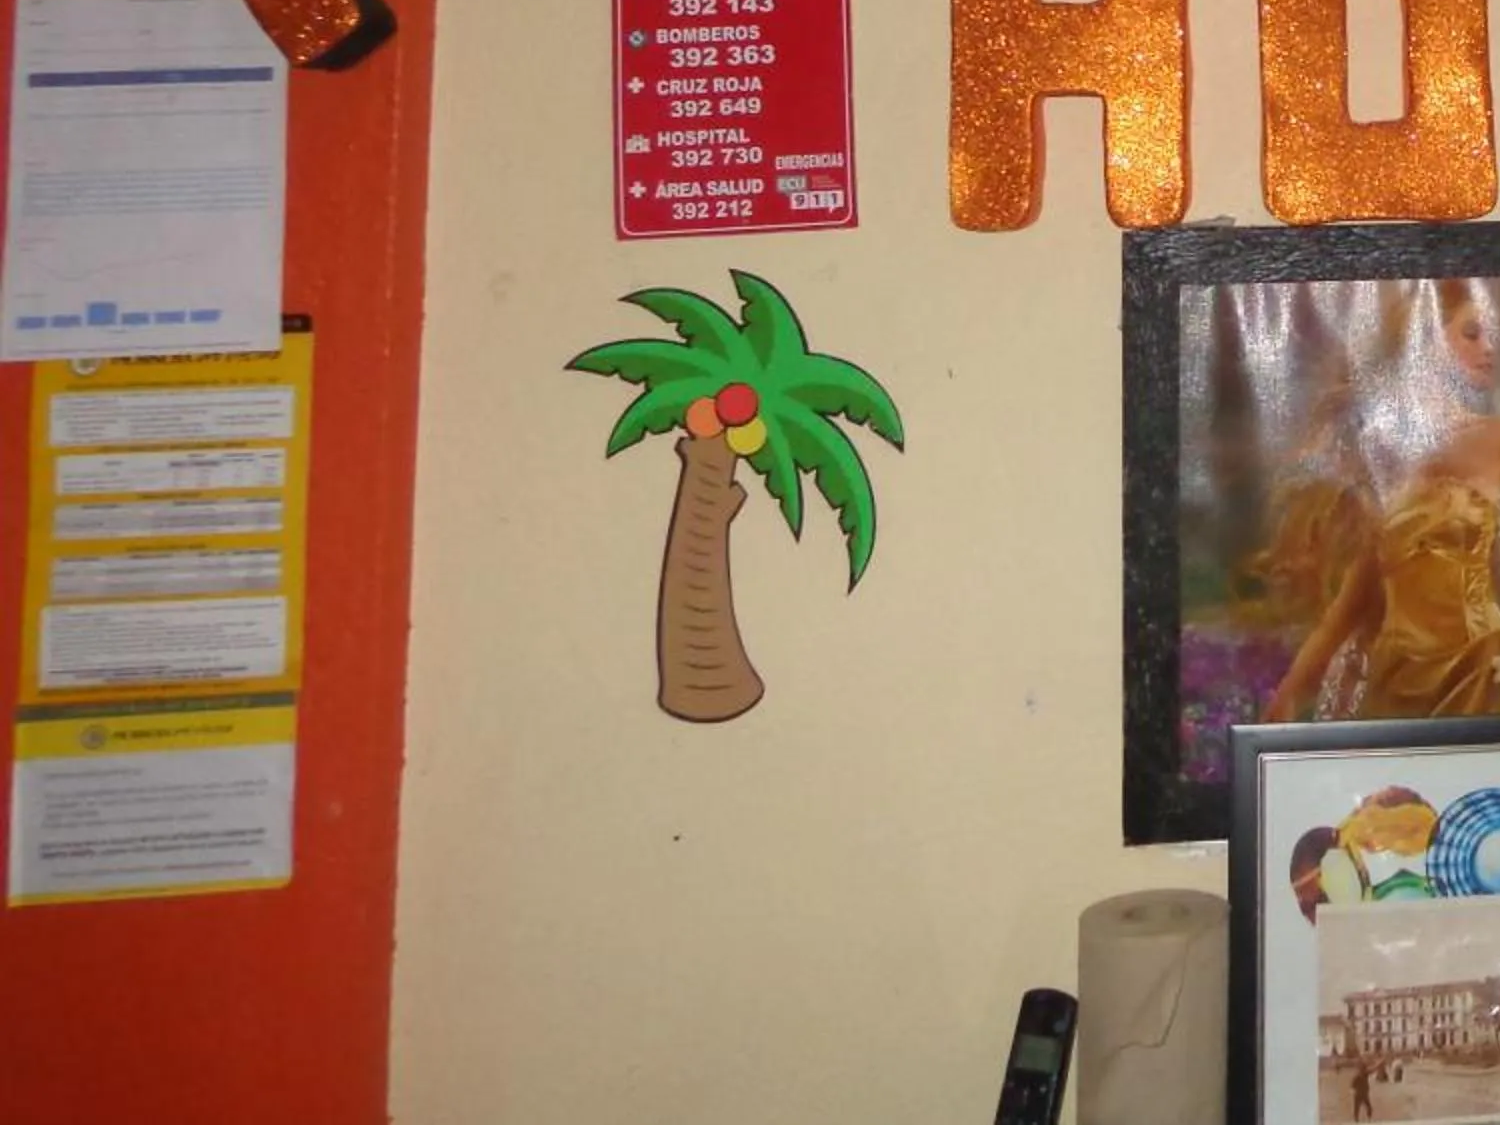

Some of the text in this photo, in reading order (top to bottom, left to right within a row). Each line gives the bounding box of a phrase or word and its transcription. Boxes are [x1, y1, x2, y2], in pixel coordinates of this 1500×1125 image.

[655, 25, 761, 44] BOMBEROS
[670, 44, 776, 68] 392 363
[656, 76, 763, 95] CRUZ ROJA
[670, 97, 762, 118] 392 649
[657, 127, 750, 147] HOSPITAL
[671, 146, 763, 168] 392 730
[706, 178, 764, 196] SALUD
[672, 199, 753, 220] 392 212
